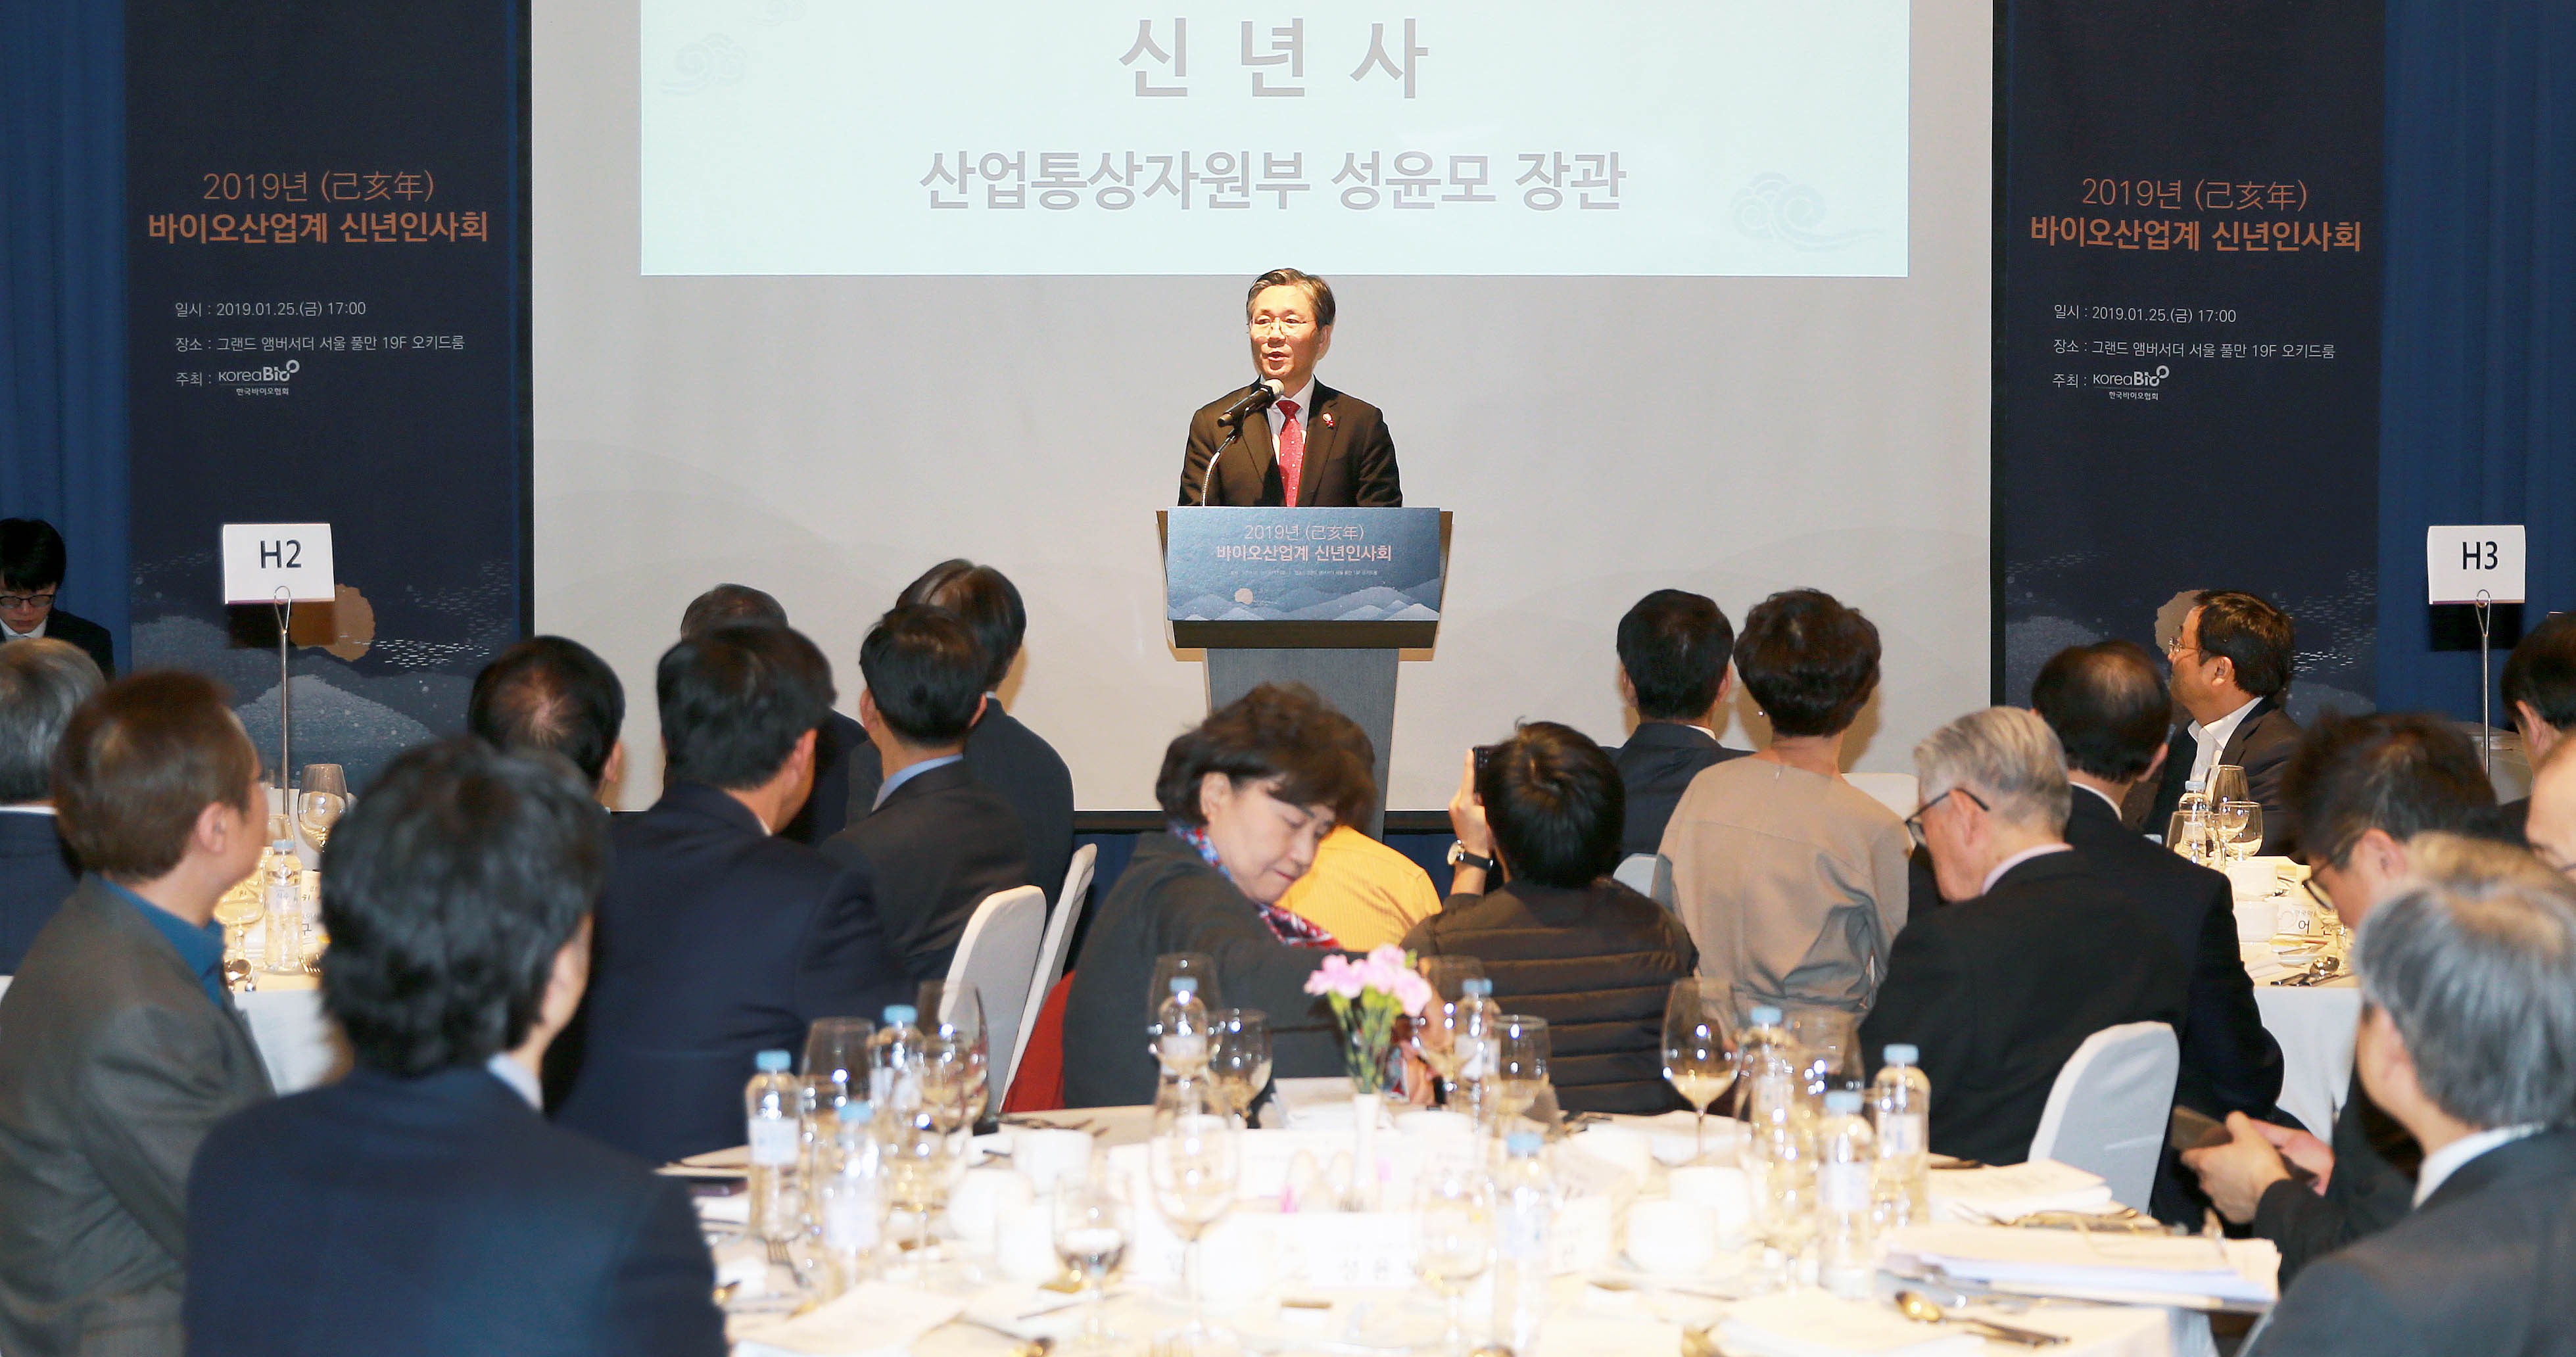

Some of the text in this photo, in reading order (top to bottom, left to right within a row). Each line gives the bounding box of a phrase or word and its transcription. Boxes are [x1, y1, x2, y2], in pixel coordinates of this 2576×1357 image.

[203, 171, 308, 202] 2019년
[920, 151, 1627, 211] 산업통상자원부 성윤모 장관
[2082, 178, 2181, 210] 2019년
[149, 211, 488, 244] 바이오산업계 신년인사회
[2031, 216, 2362, 252] 바이오산업계 신년인사회
[175, 302, 201, 318] 일시
[328, 301, 366, 315] 17:00
[2054, 304, 2079, 320] 일시
[2198, 309, 2237, 323] 17:00
[176, 337, 203, 352] 장소
[216, 337, 257, 352] 그랜드
[261, 336, 314, 352] 앰버서더
[319, 336, 346, 351] 서울
[350, 336, 377, 351] 풀만
[383, 336, 407, 349] 19F
[412, 335, 465, 350] 오키드룸
[2053, 339, 2080, 354] 장소
[2091, 341, 2129, 356] 그랜드
[2133, 342, 2184, 358] 앰버서더
[2189, 343, 2216, 358] 서울
[2220, 343, 2247, 358] 풀만
[2253, 344, 2277, 358] 19F
[2281, 344, 2335, 359] 오키드룸
[176, 372, 203, 387] 주최
[2052, 373, 2078, 389] 주최
[236, 387, 289, 396] 한국바이오협회
[2109, 391, 2159, 401] 한국바이오협회
[1244, 524, 1299, 541] 2019년
[260, 540, 301, 569] H2
[1215, 544, 1391, 562] 바이오산업계 신년인사회
[2462, 541, 2498, 570] H3
